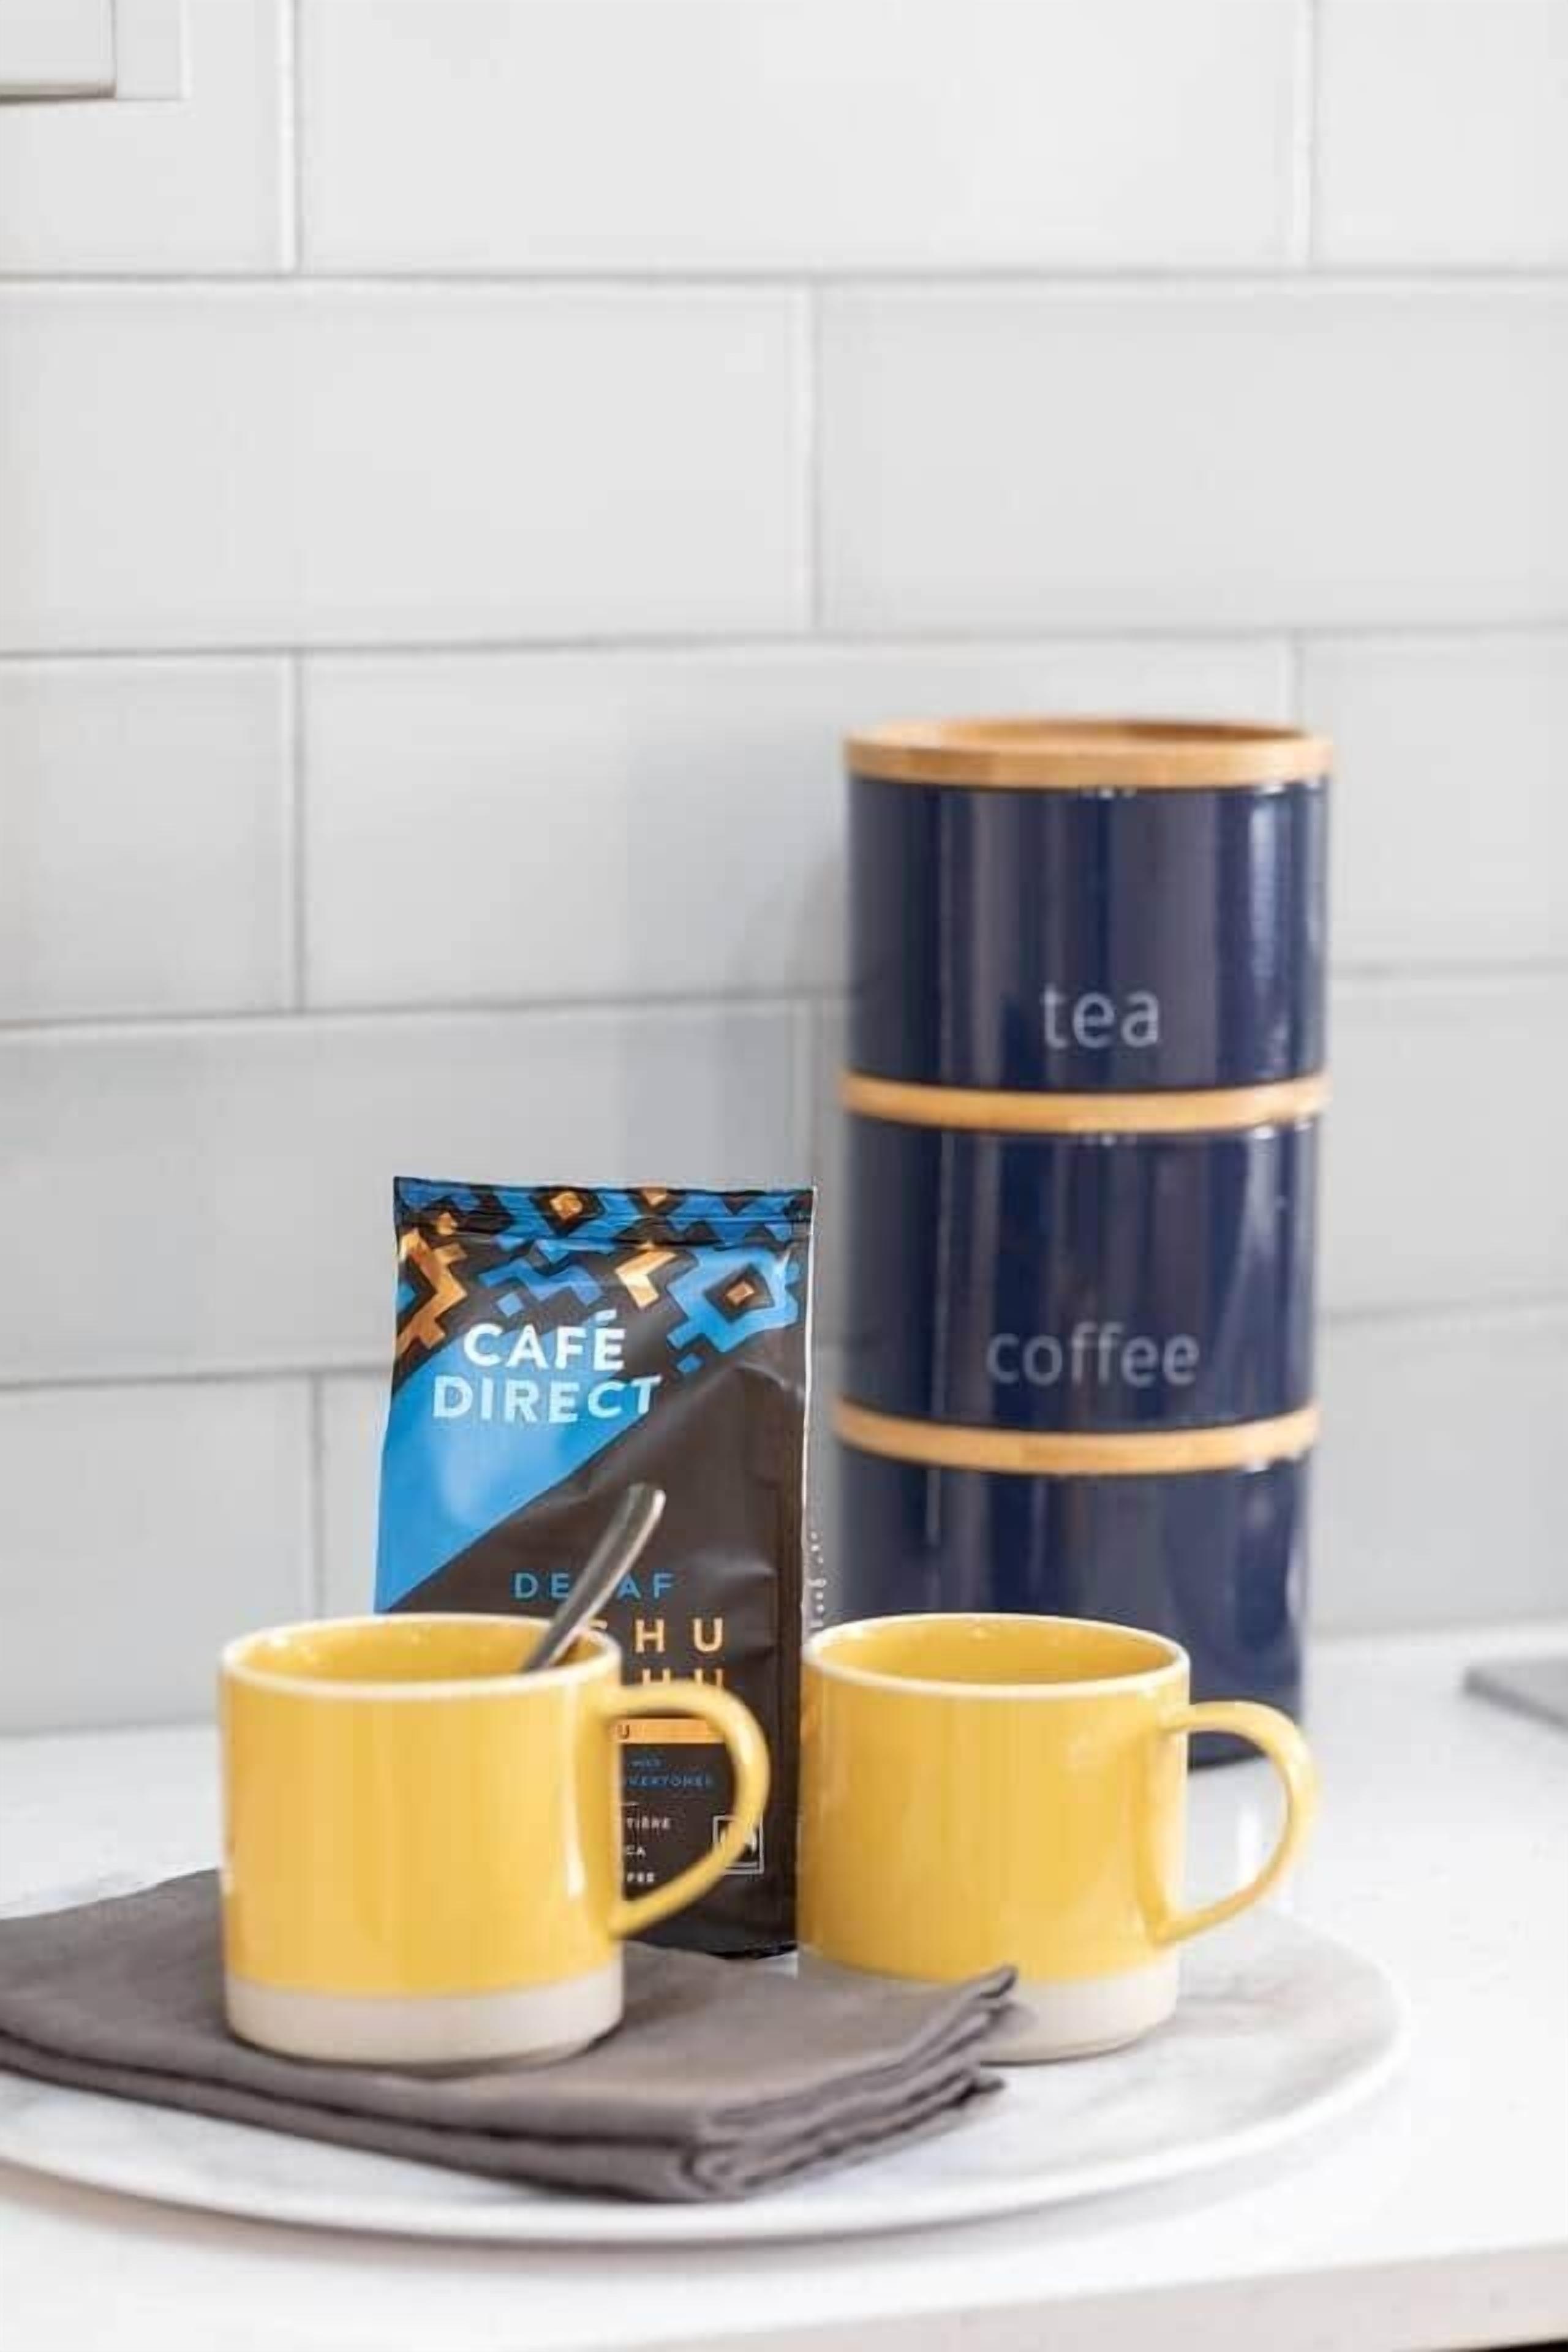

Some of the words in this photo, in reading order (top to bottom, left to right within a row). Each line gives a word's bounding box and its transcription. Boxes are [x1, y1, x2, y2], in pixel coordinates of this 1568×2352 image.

[1040, 983, 1161, 1049] tea
[463, 1310, 626, 1371] CAFÉ
[986, 1322, 1200, 1387] coffee
[433, 1375, 662, 1423] DIRECT
[514, 1572, 673, 1599] DEAF
[588, 1618, 723, 1653] HU
